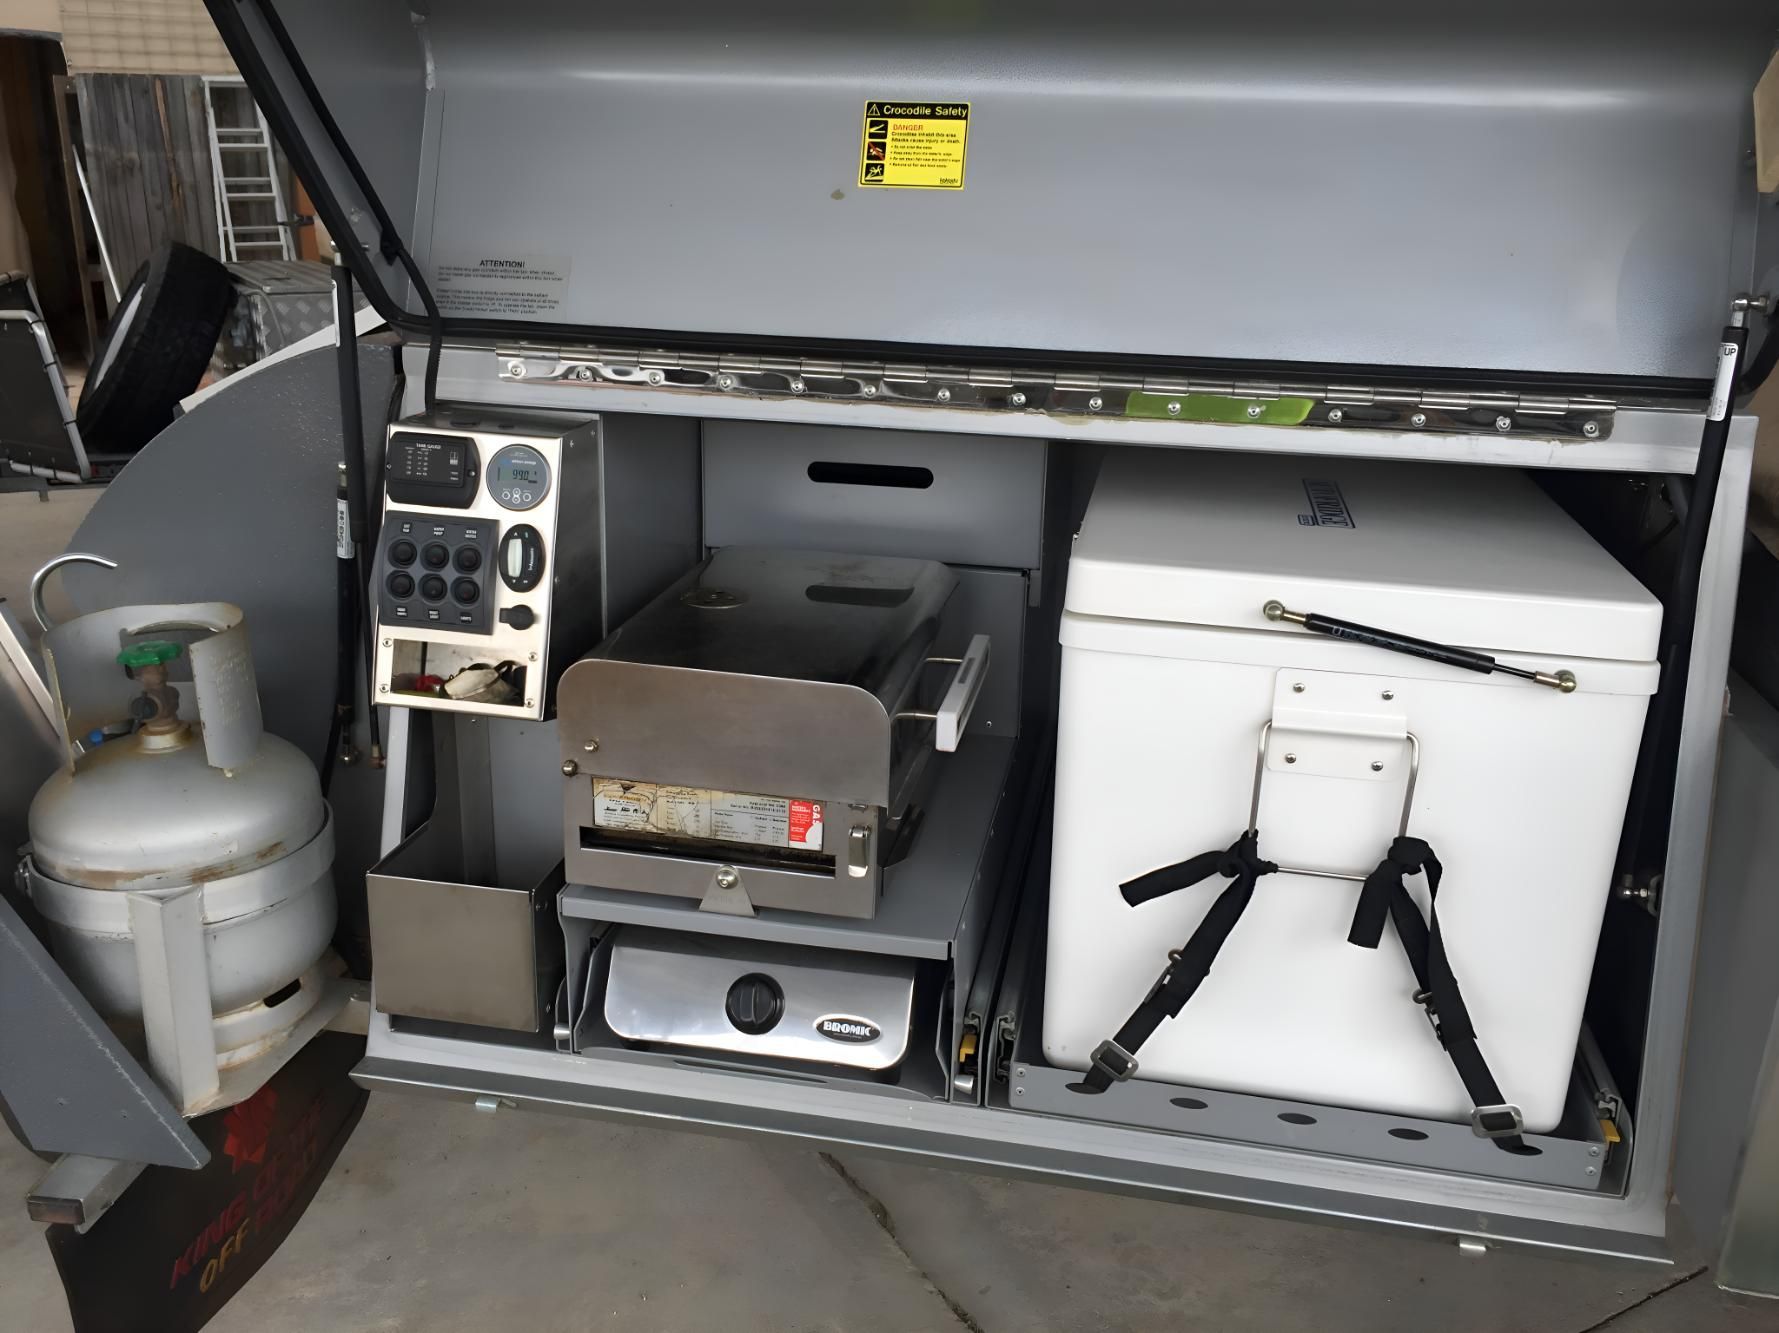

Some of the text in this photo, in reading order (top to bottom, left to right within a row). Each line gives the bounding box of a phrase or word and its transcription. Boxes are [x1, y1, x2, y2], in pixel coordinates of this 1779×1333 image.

[883, 105, 968, 118] Crocodile Safety
[480, 260, 525, 268] ATTENTION!
[199, 1216, 250, 1293] OFF
